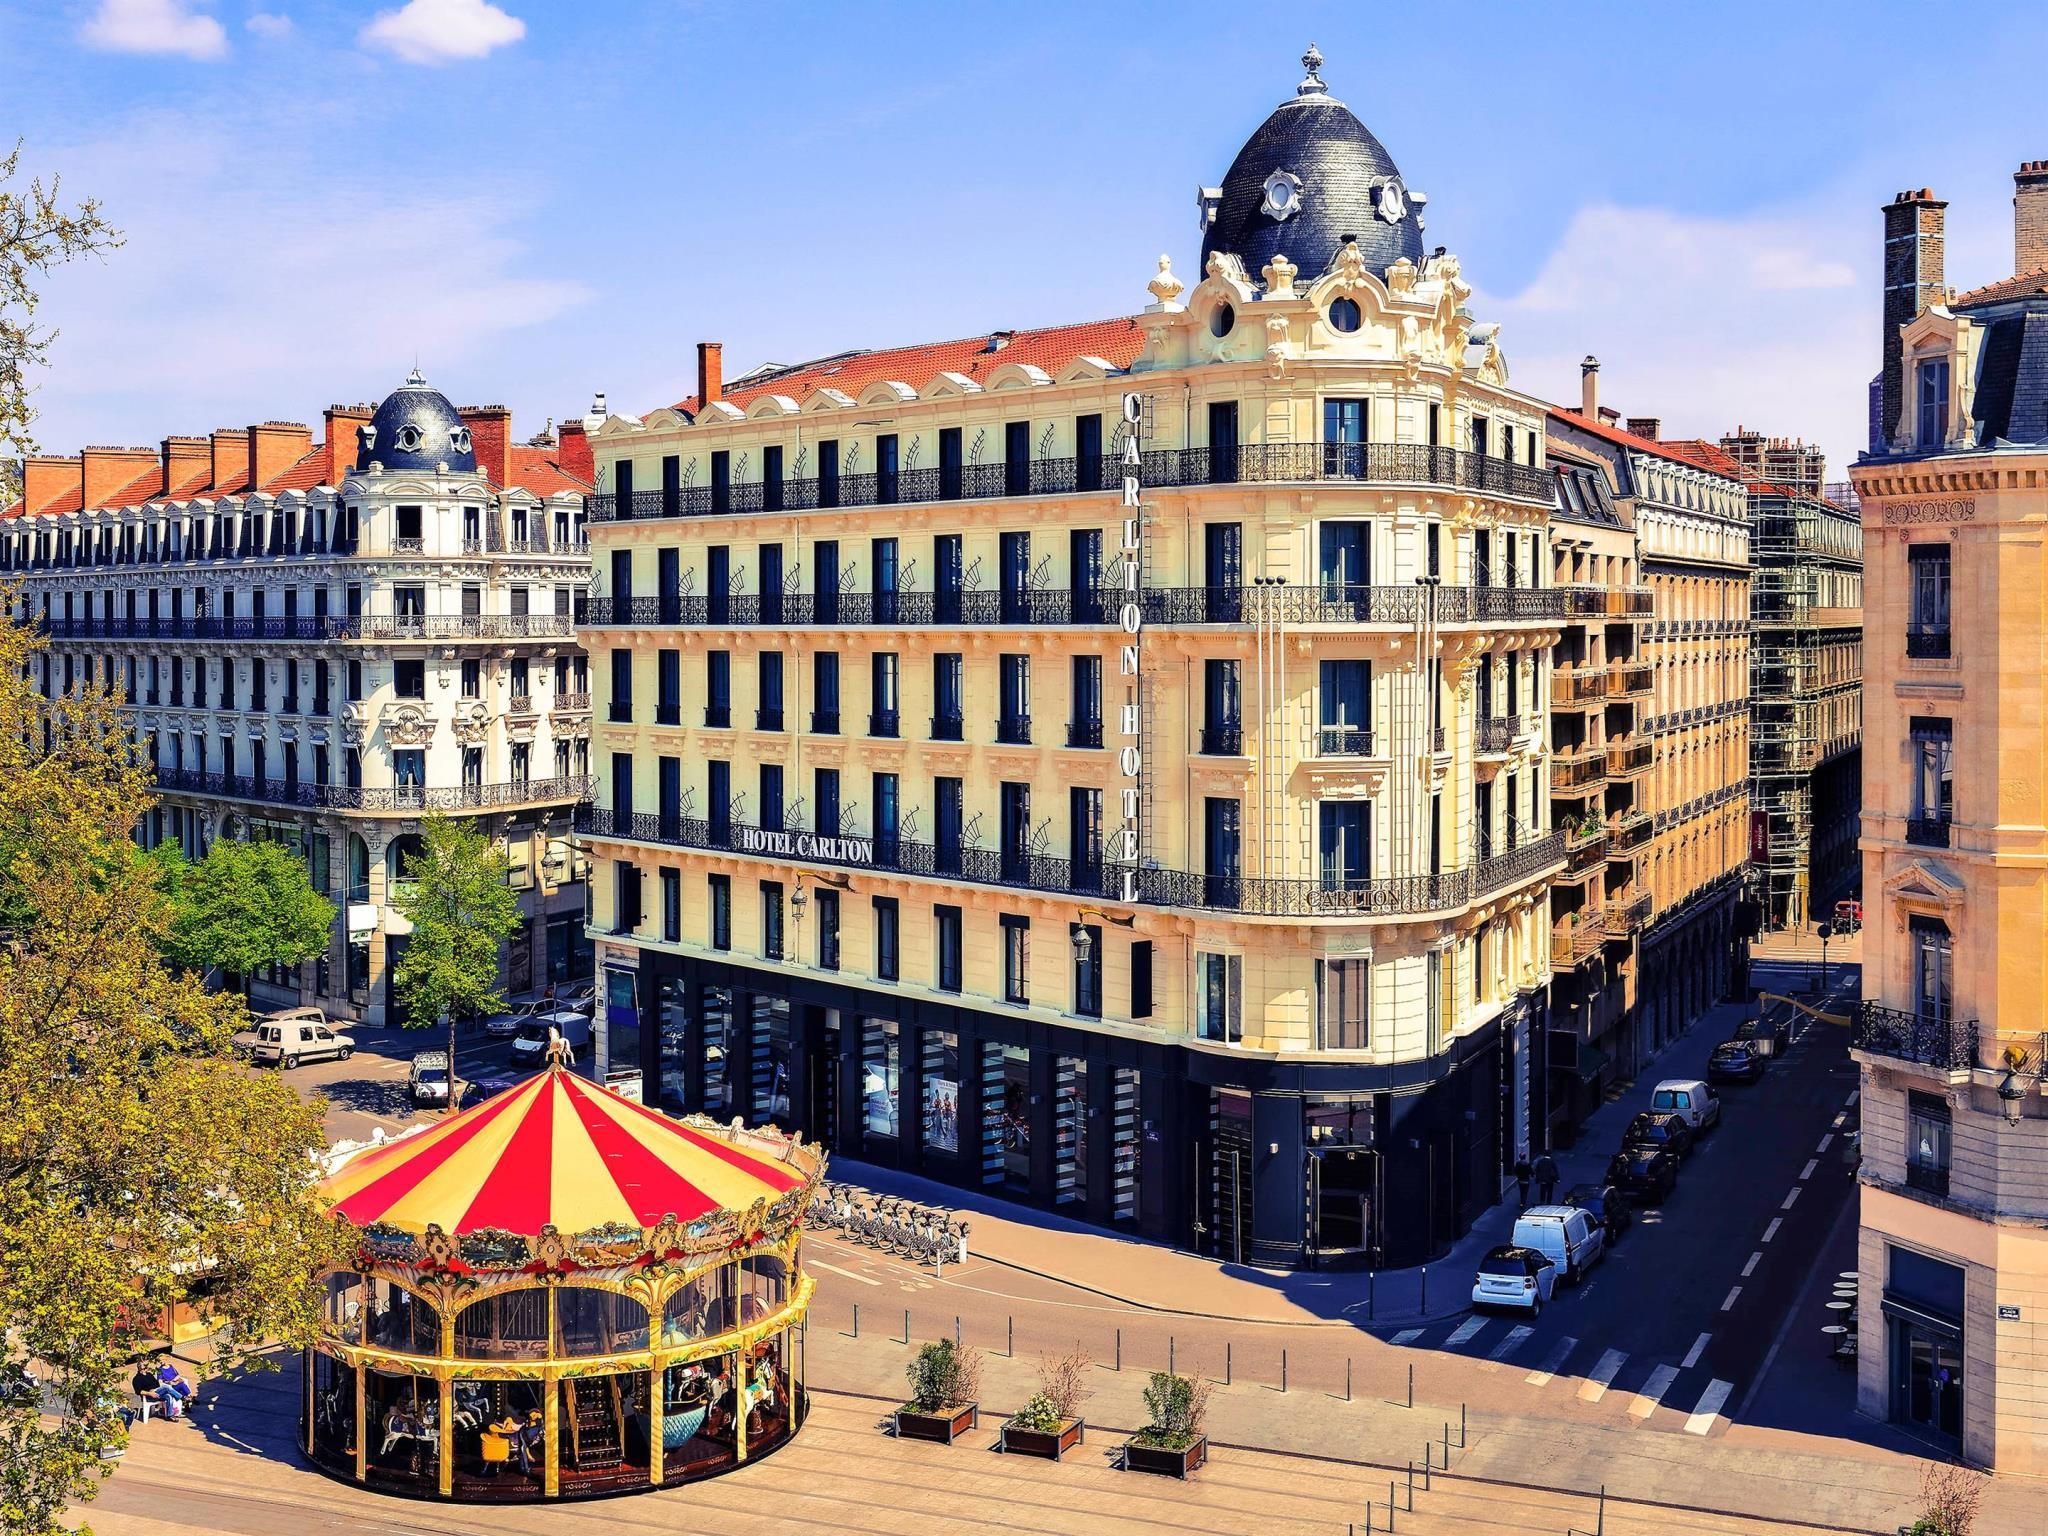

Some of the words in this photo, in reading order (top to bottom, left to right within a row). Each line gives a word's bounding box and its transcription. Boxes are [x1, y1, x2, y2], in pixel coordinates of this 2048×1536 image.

[1120, 392, 1141, 676] CARLTON
[743, 828, 796, 854] HOTEL
[797, 835, 874, 864] CARLTON
[1119, 704, 1141, 903] HOTEL
[1306, 889, 1402, 908] CARLTON
